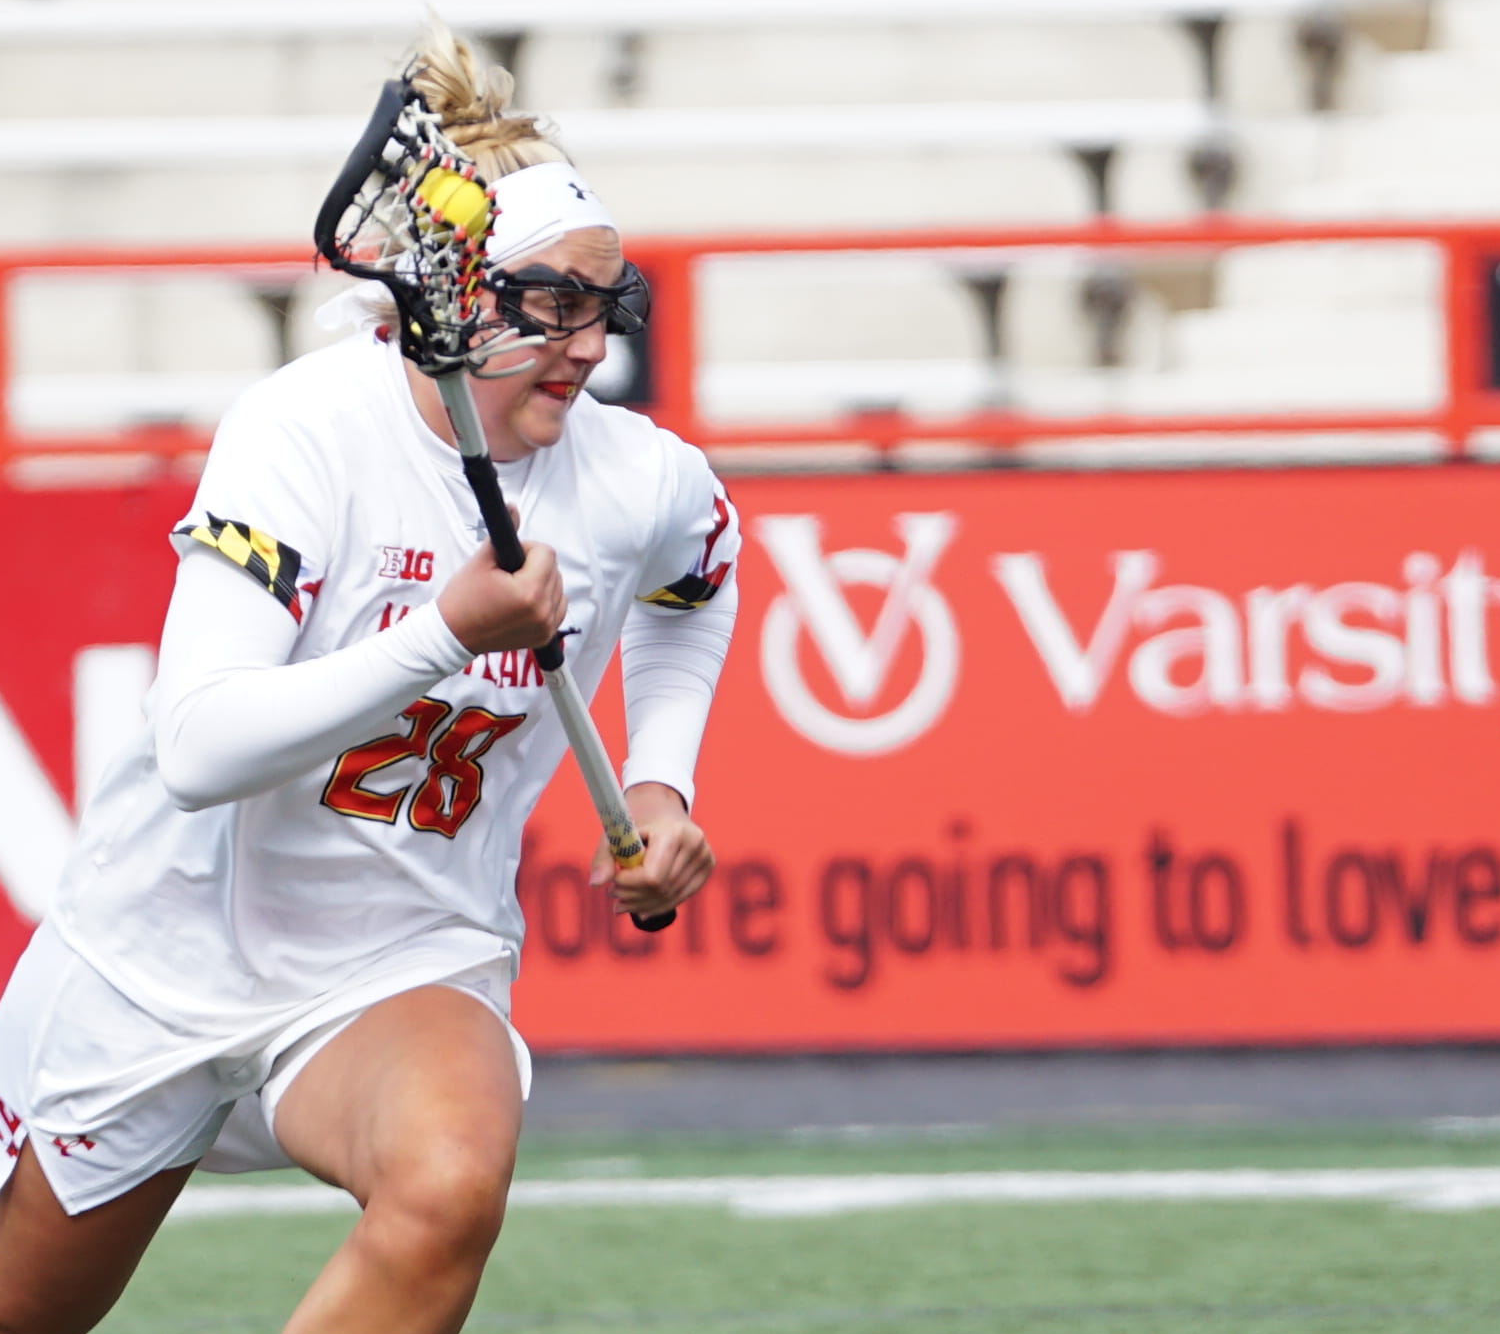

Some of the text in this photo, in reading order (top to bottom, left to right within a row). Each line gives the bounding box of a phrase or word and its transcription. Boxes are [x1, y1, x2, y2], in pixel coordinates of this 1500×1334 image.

[320, 696, 528, 841] 28
[821, 815, 1110, 991] going
[1145, 828, 1243, 952] to
